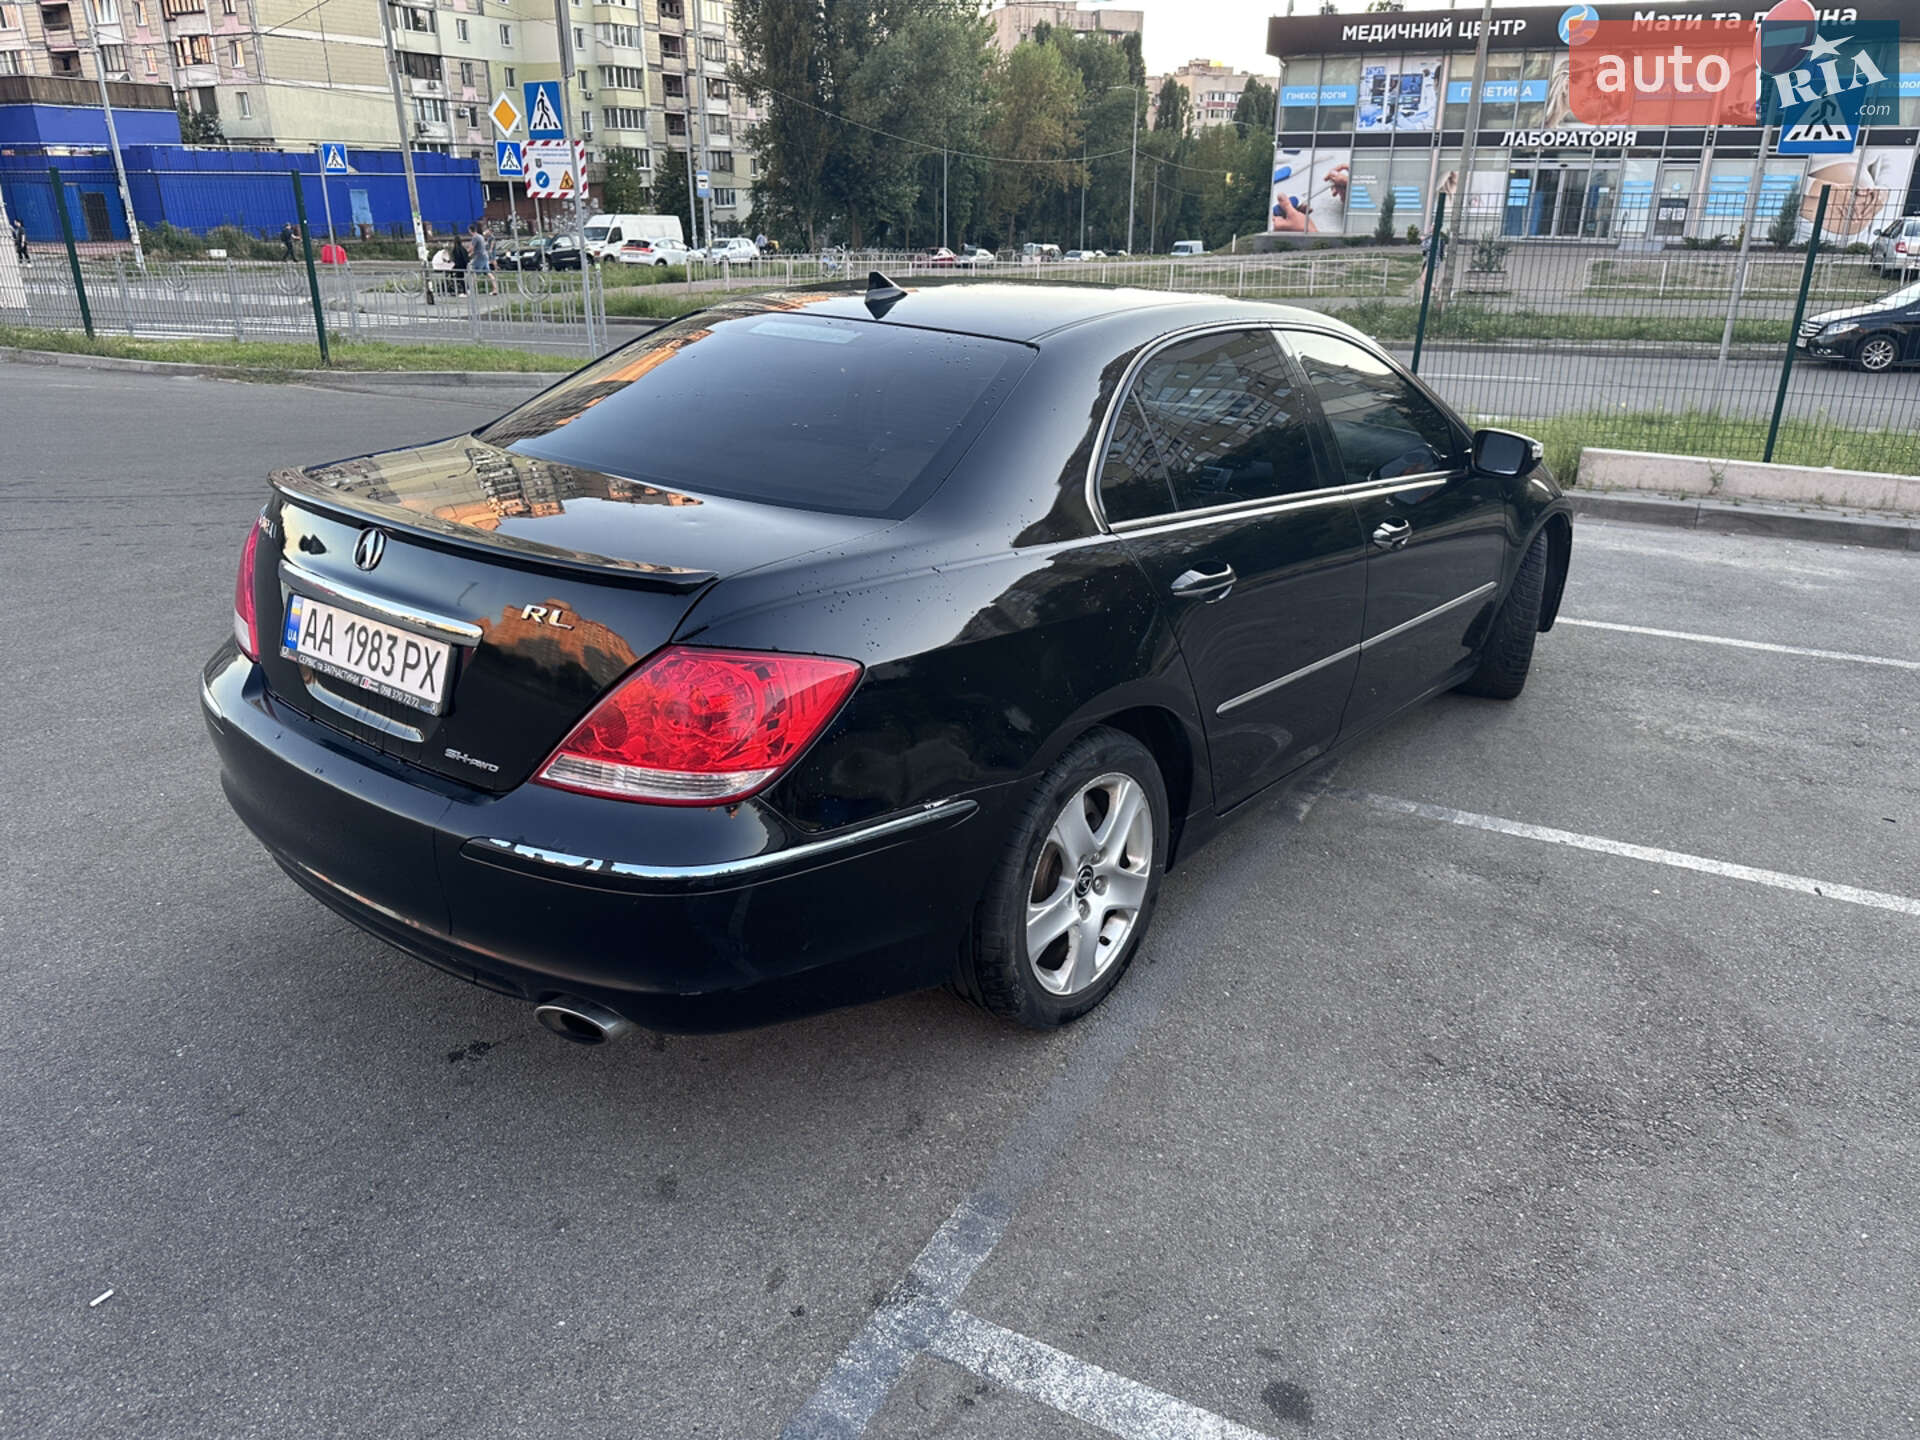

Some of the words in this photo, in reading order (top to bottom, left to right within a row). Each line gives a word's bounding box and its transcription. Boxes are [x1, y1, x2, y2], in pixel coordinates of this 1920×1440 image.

[1342, 18, 1452, 43] МЕДИЧНИЙ
[1458, 19, 1527, 40] ЦЕНТР
[1500, 130, 1637, 147] ЛАБОРАТОРІЯ
[521, 603, 575, 631] RL
[301, 607, 334, 657] AA
[344, 621, 399, 677] 1983
